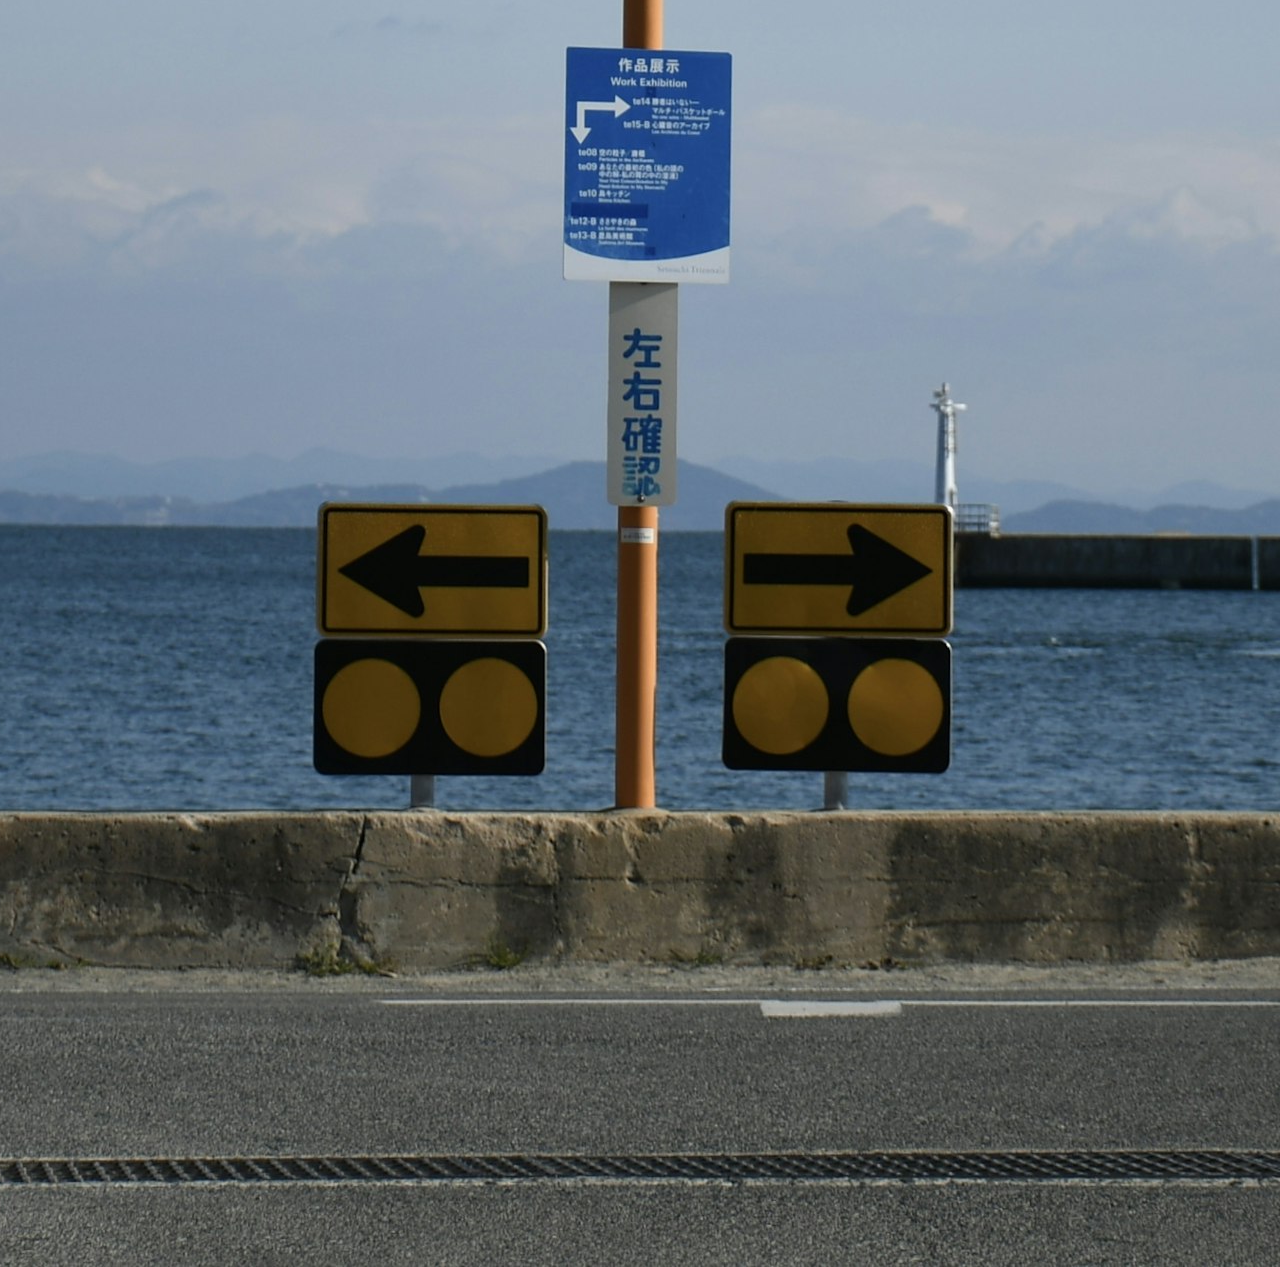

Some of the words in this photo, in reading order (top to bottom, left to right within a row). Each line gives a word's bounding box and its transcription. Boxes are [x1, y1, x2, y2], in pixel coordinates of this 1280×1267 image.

[618, 57, 680, 74] 作品展示
[610, 76, 637, 87] Work
[639, 77, 688, 88] Exhibition
[621, 327, 663, 497] 左右確認
